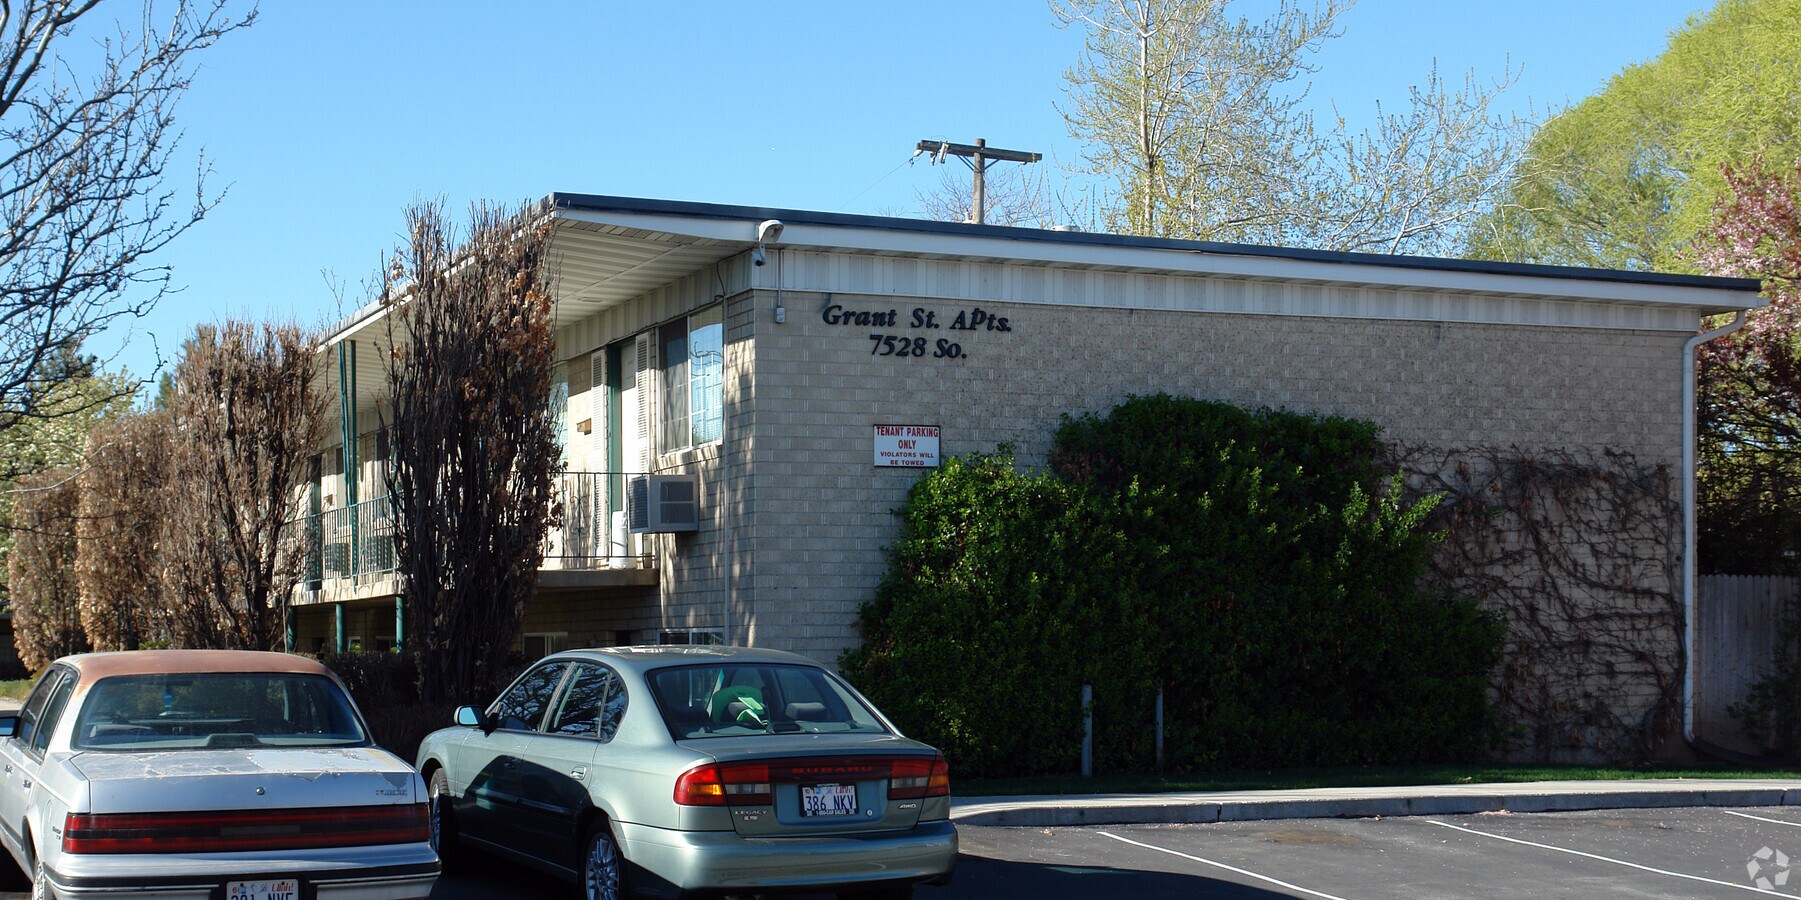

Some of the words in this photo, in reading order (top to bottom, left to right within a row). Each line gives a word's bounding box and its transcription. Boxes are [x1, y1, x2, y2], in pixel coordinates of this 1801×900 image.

[822, 305, 897, 327] Grant
[911, 308, 940, 329] St.
[869, 334, 927, 357] 7528
[934, 338, 967, 359] So.
[876, 426, 904, 437] TENANT
[906, 427, 939, 438] PARKING
[898, 439, 917, 450] ONLY
[791, 766, 872, 774] SUBARU
[805, 795, 827, 811] 386
[833, 795, 854, 810] NKV
